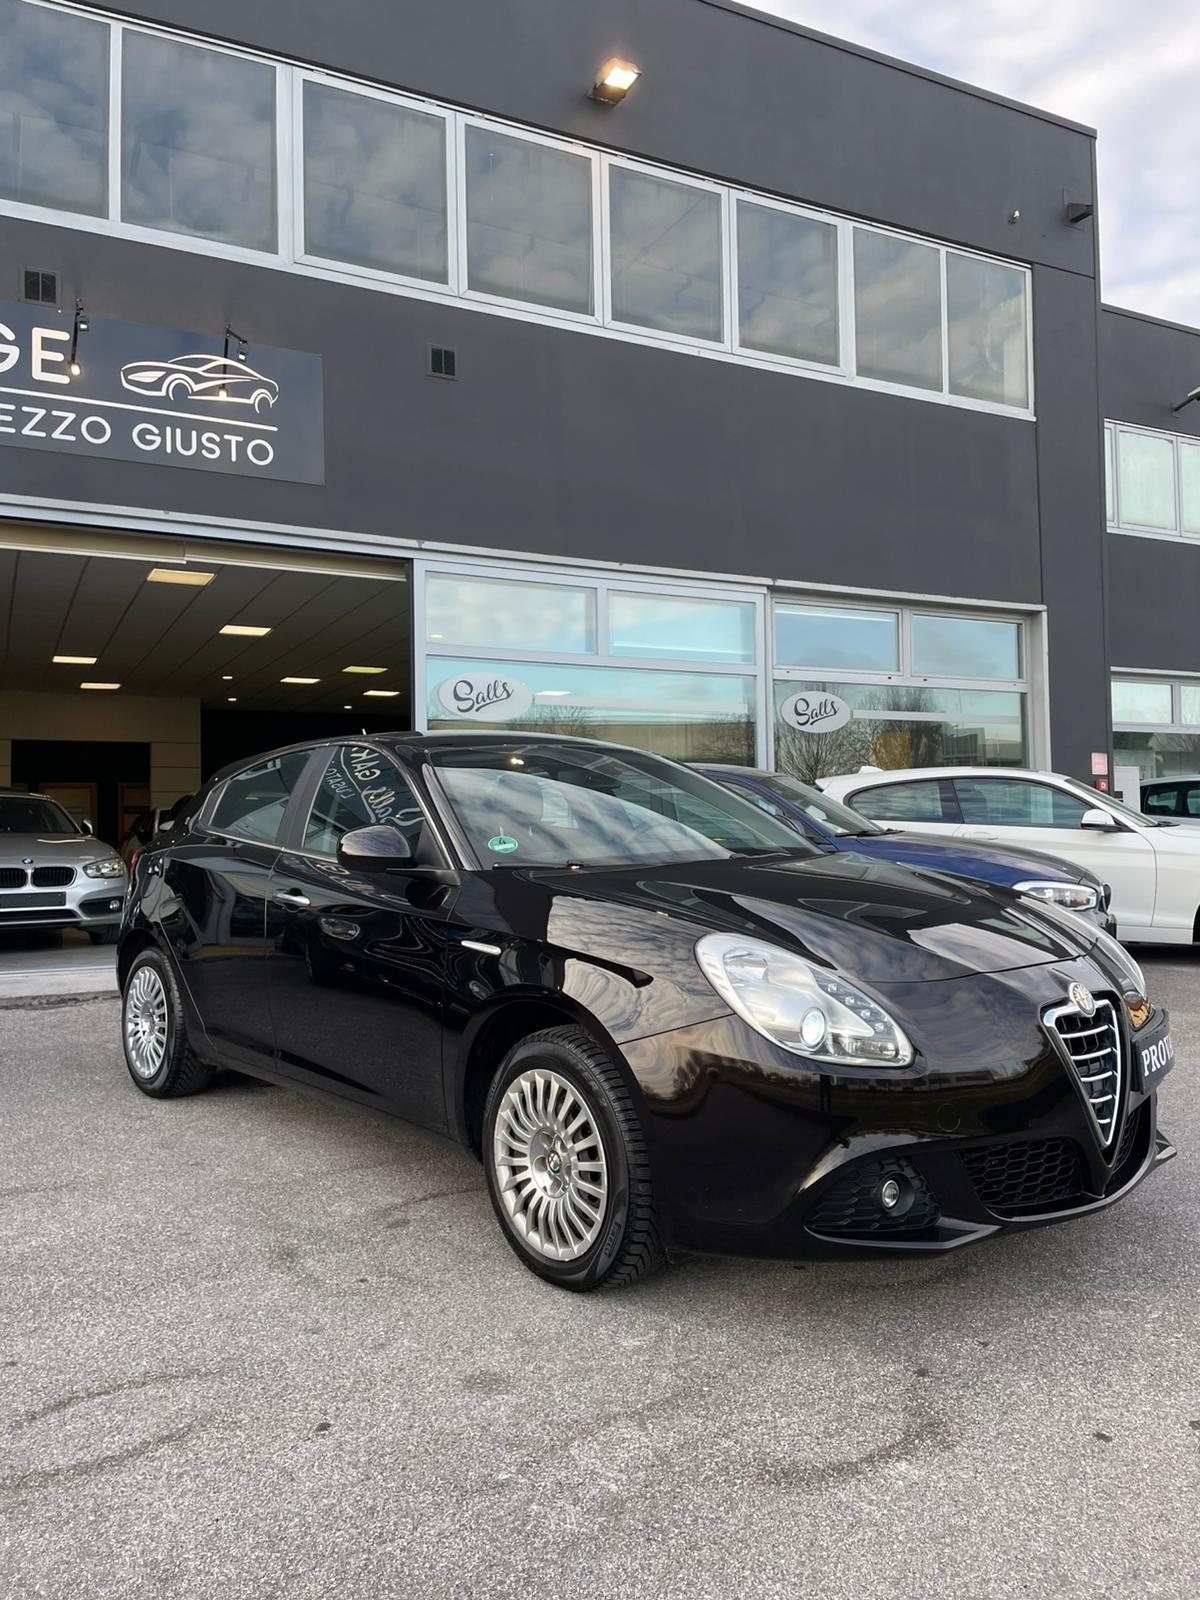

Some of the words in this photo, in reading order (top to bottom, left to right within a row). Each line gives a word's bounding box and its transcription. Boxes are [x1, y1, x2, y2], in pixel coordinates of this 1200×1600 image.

[0, 403, 111, 444] EZZO
[132, 423, 274, 466] GIUSTO
[1141, 1035, 1174, 1077] PROV
